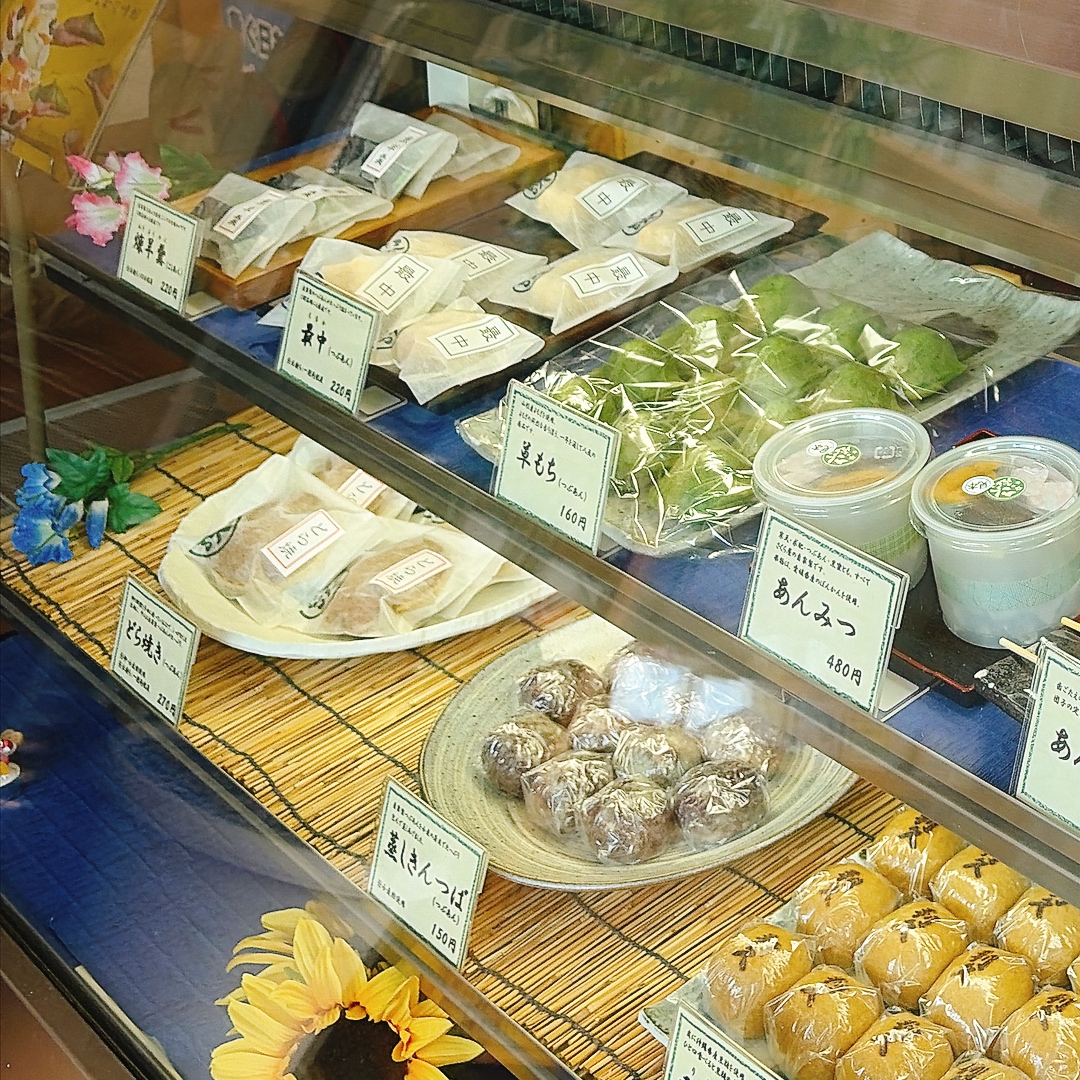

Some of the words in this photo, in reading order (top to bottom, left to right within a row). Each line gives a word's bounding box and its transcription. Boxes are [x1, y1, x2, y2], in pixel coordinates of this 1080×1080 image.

[379, 264, 416, 298] 最中
[301, 322, 327, 355] 最中
[450, 326, 501, 348] 最中
[330, 380, 352, 403] 220円
[516, 440, 557, 482] 草もち
[559, 504, 588, 532] 160円
[773, 577, 856, 637] あんみつ
[126, 619, 162, 665] どら焼き
[826, 654, 862, 687] 480円
[384, 829, 469, 913] 蒸しきんつば
[431, 923, 457, 954] 150円
